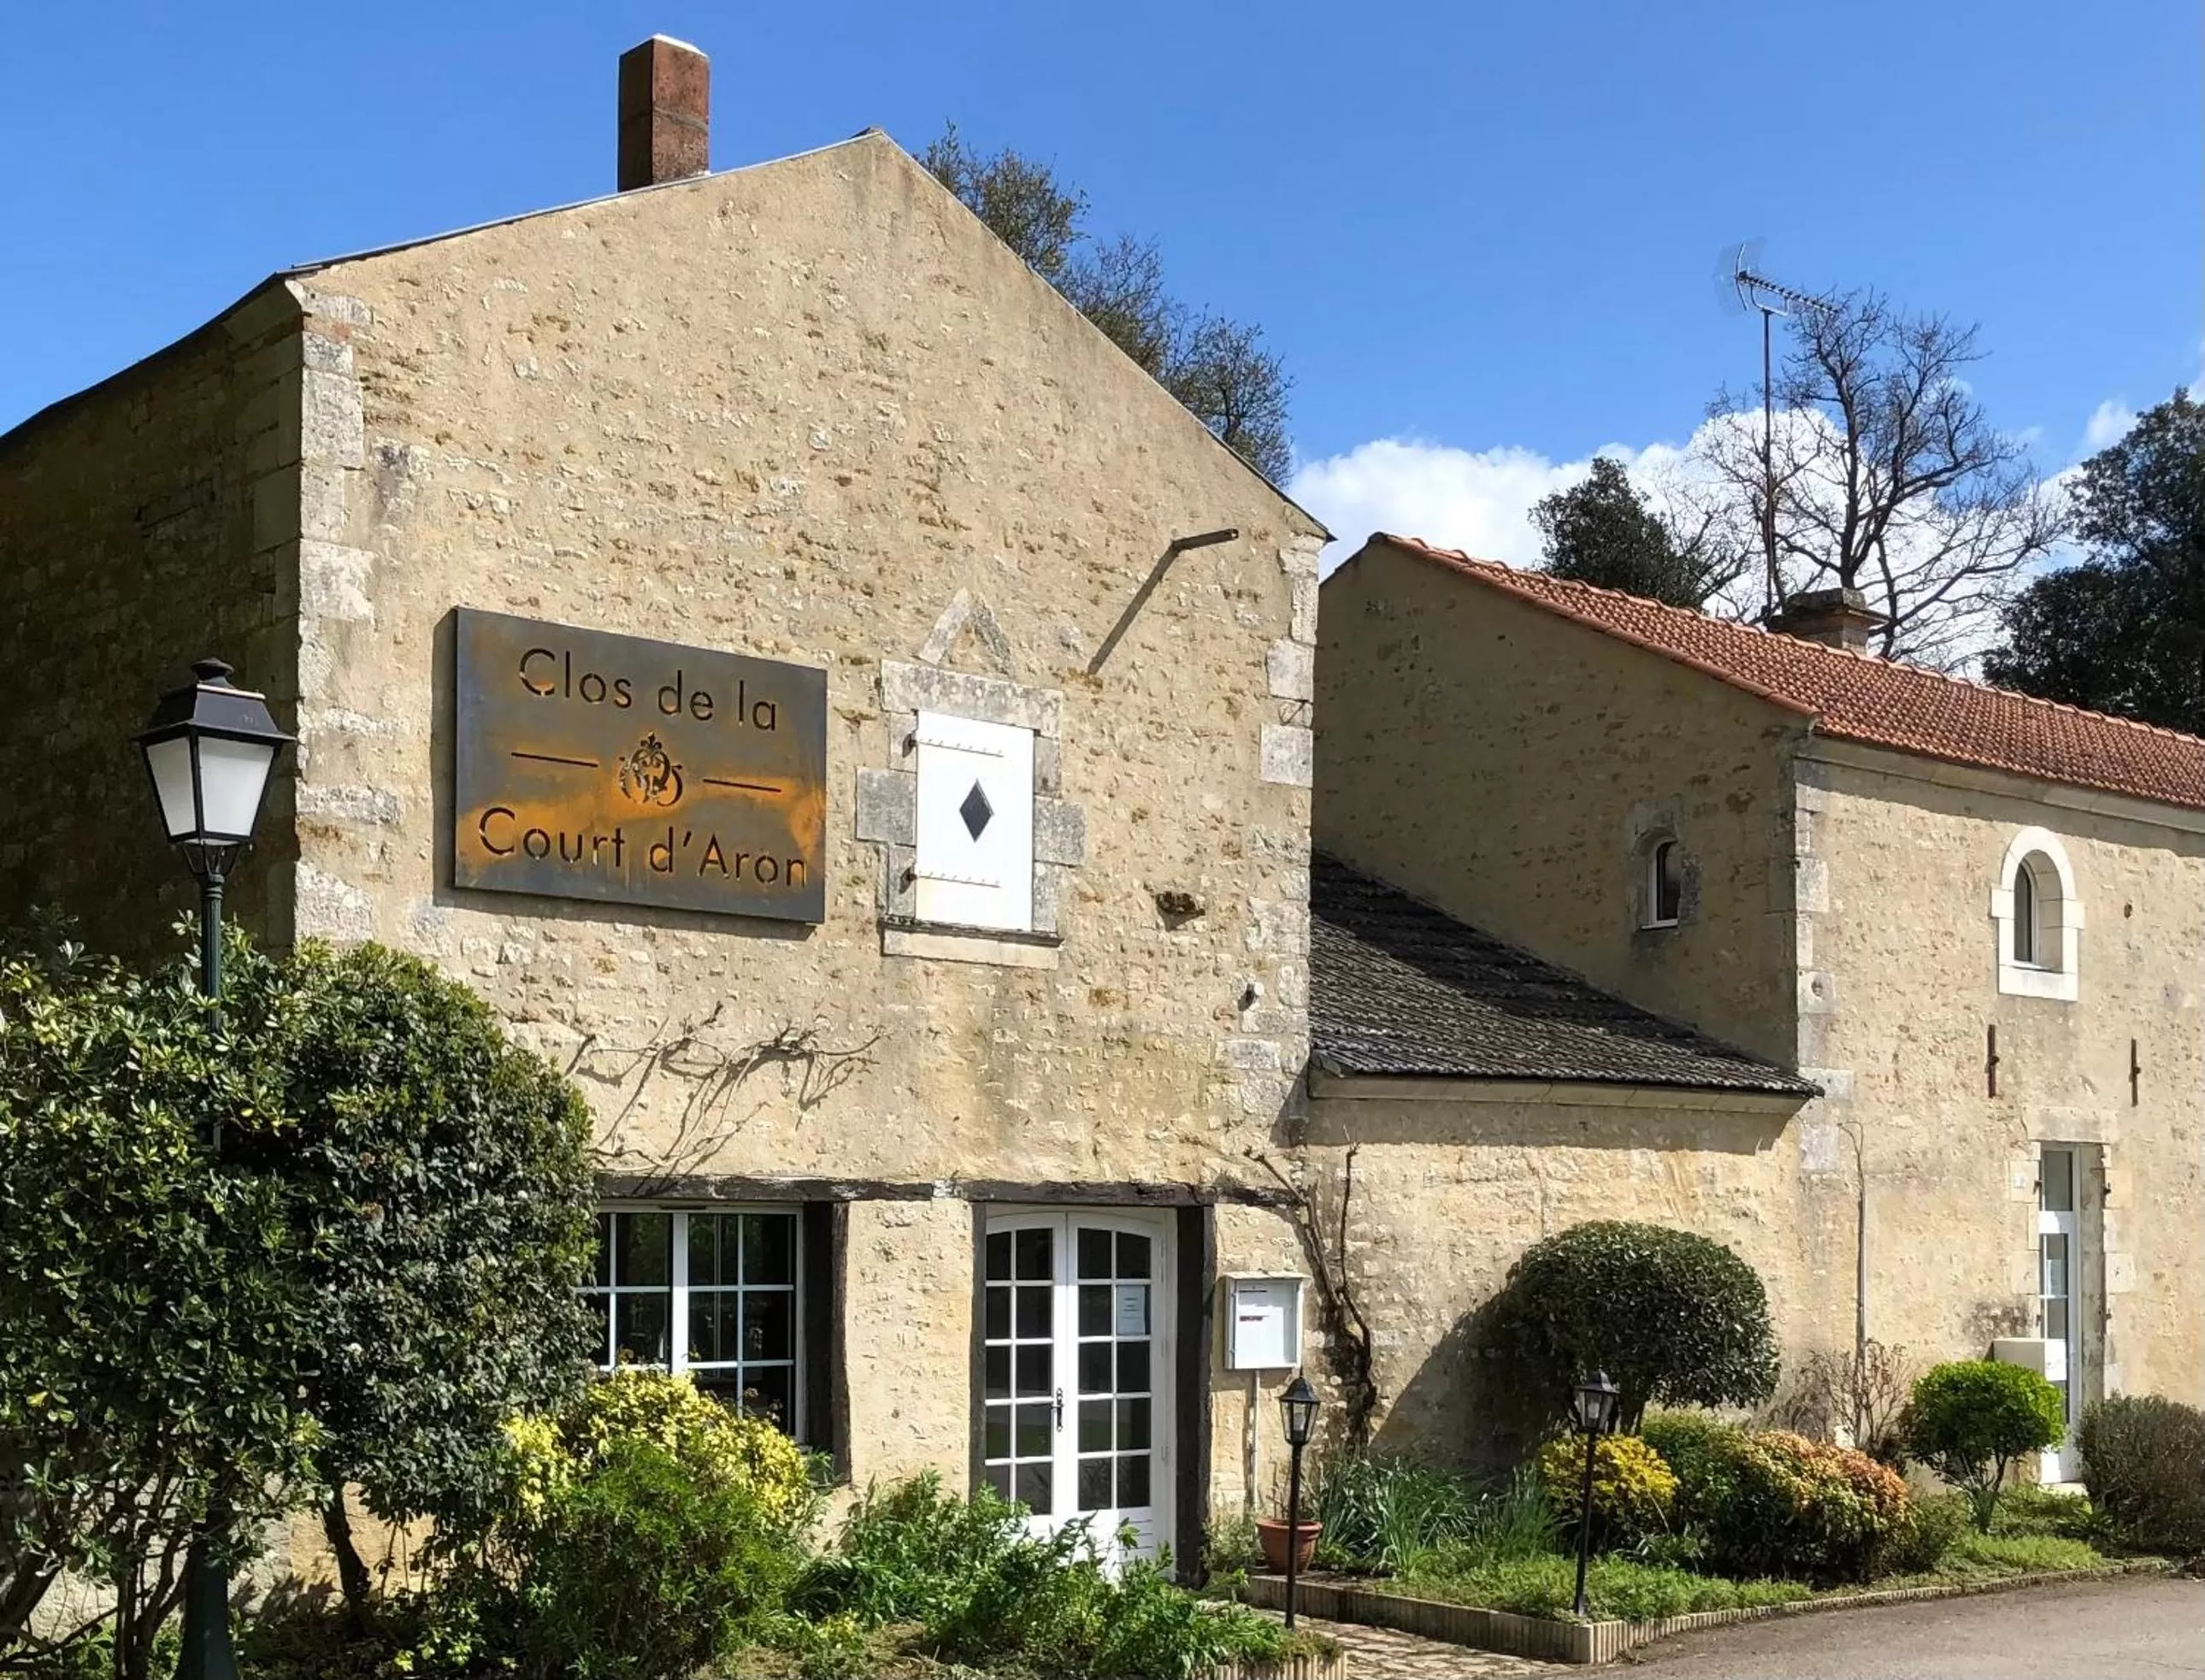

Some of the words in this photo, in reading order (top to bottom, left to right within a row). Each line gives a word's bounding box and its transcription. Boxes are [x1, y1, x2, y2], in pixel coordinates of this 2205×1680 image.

[518, 647, 633, 709] Clos
[657, 669, 715, 722] de
[738, 680, 776, 731] la
[478, 807, 626, 868] Court
[649, 826, 807, 887] d'Aron
